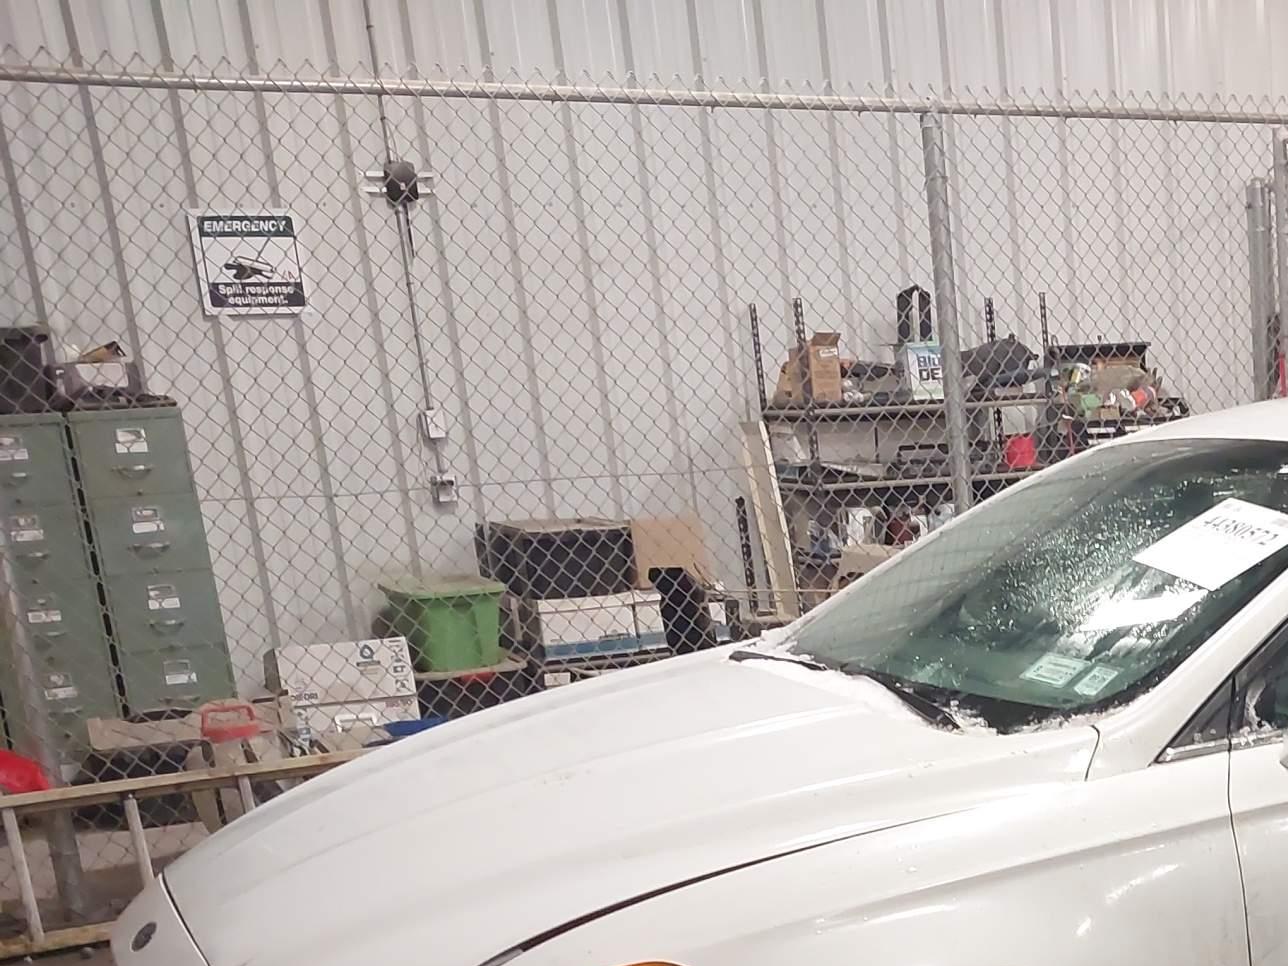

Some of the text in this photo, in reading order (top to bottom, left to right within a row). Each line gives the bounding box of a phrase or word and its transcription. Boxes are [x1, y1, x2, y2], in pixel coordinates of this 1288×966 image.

[203, 220, 287, 232] EMERGENCY
[245, 285, 295, 295] response
[1203, 515, 1279, 545] 44380572
